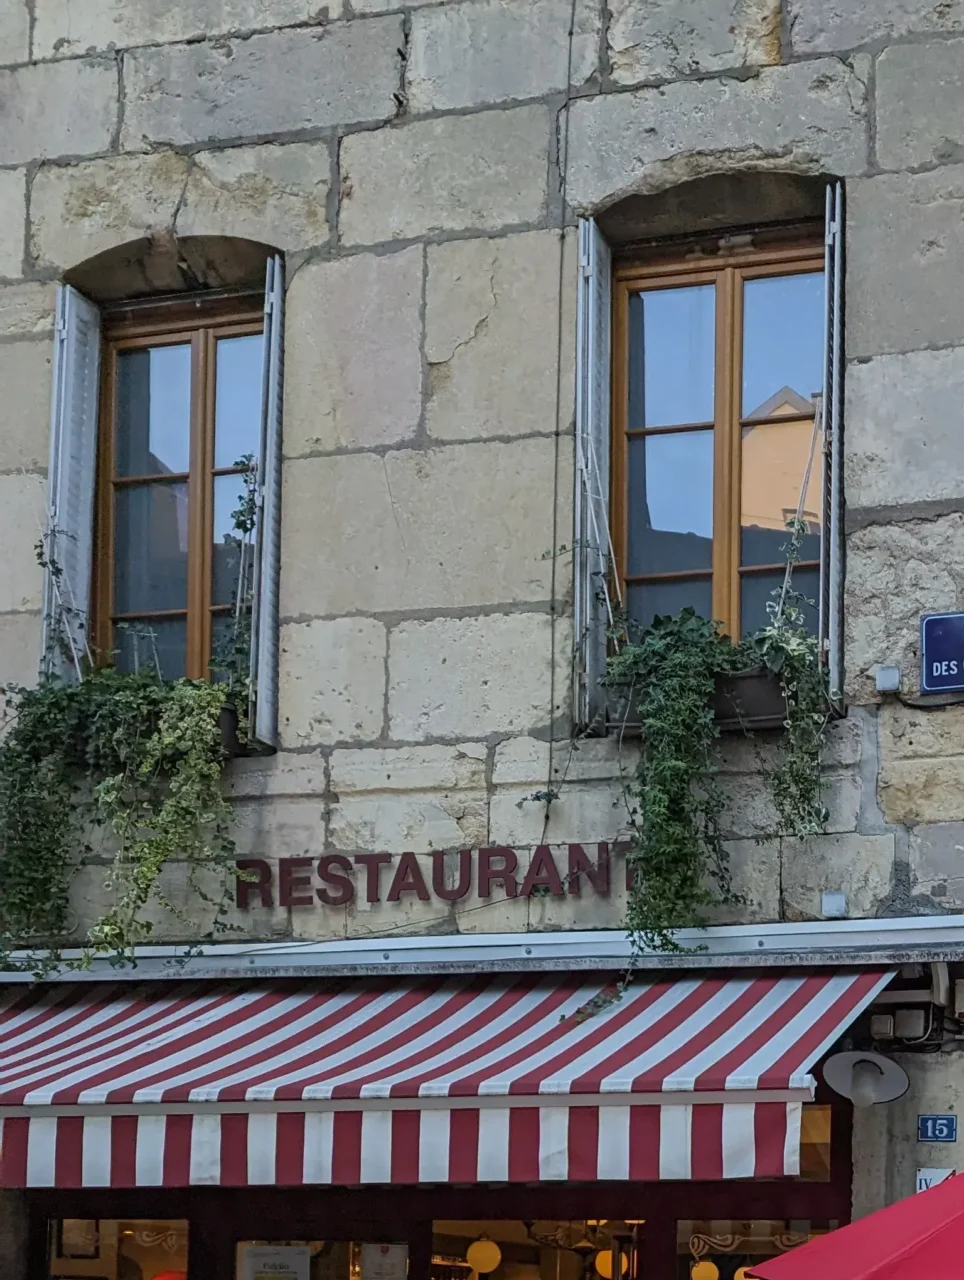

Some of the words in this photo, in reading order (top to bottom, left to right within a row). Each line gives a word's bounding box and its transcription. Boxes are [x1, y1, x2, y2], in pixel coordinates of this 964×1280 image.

[932, 660, 958, 677] DES
[926, 1119, 949, 1138] 15
[918, 1177, 932, 1190] IV
